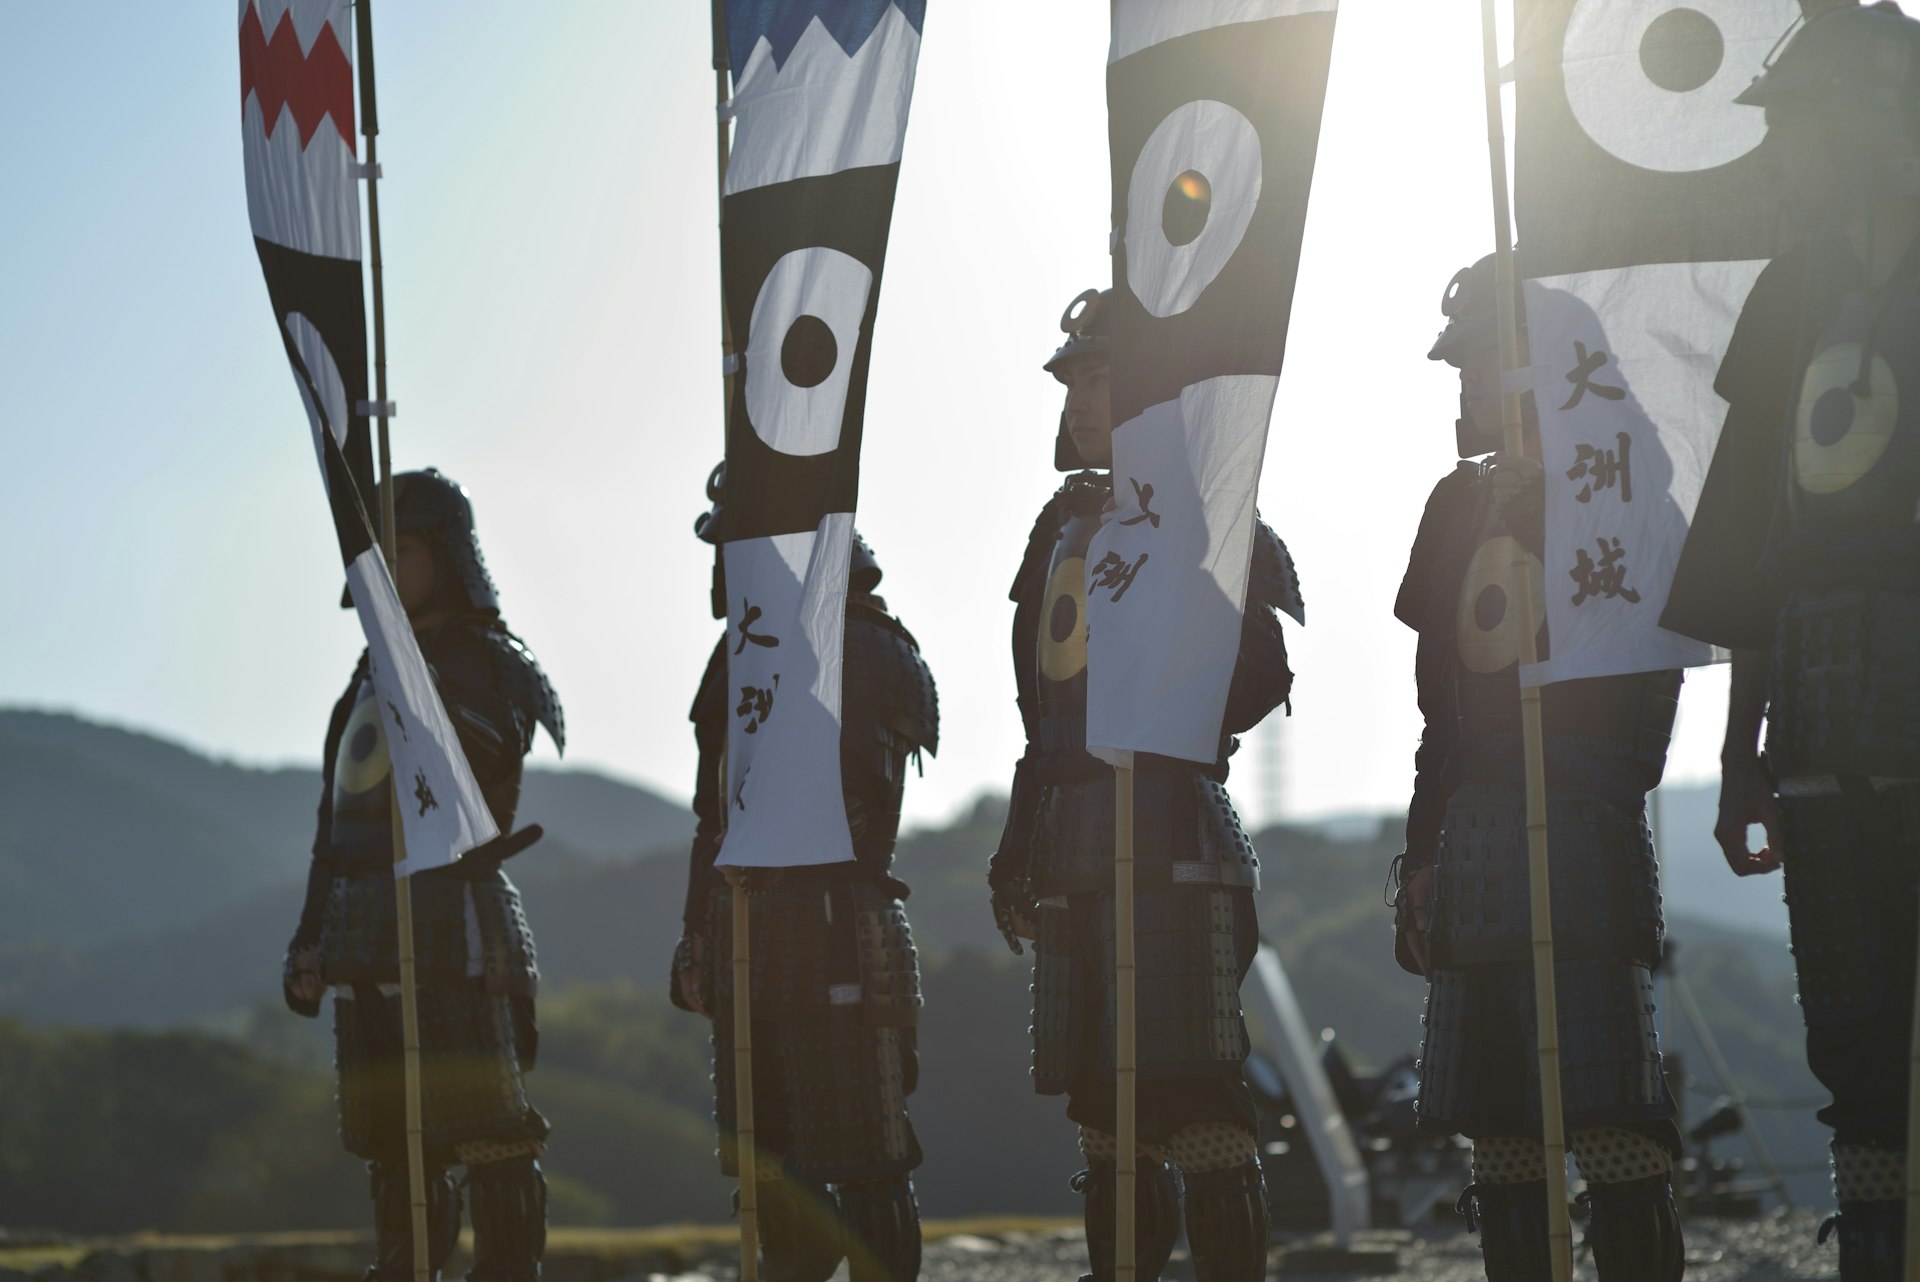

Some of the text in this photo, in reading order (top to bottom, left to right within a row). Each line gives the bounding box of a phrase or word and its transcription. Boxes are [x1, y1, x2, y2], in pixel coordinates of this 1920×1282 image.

[1085, 477, 1160, 642] 大洲
[1558, 340, 1641, 607] 大洲城
[733, 596, 780, 811] 大洲
